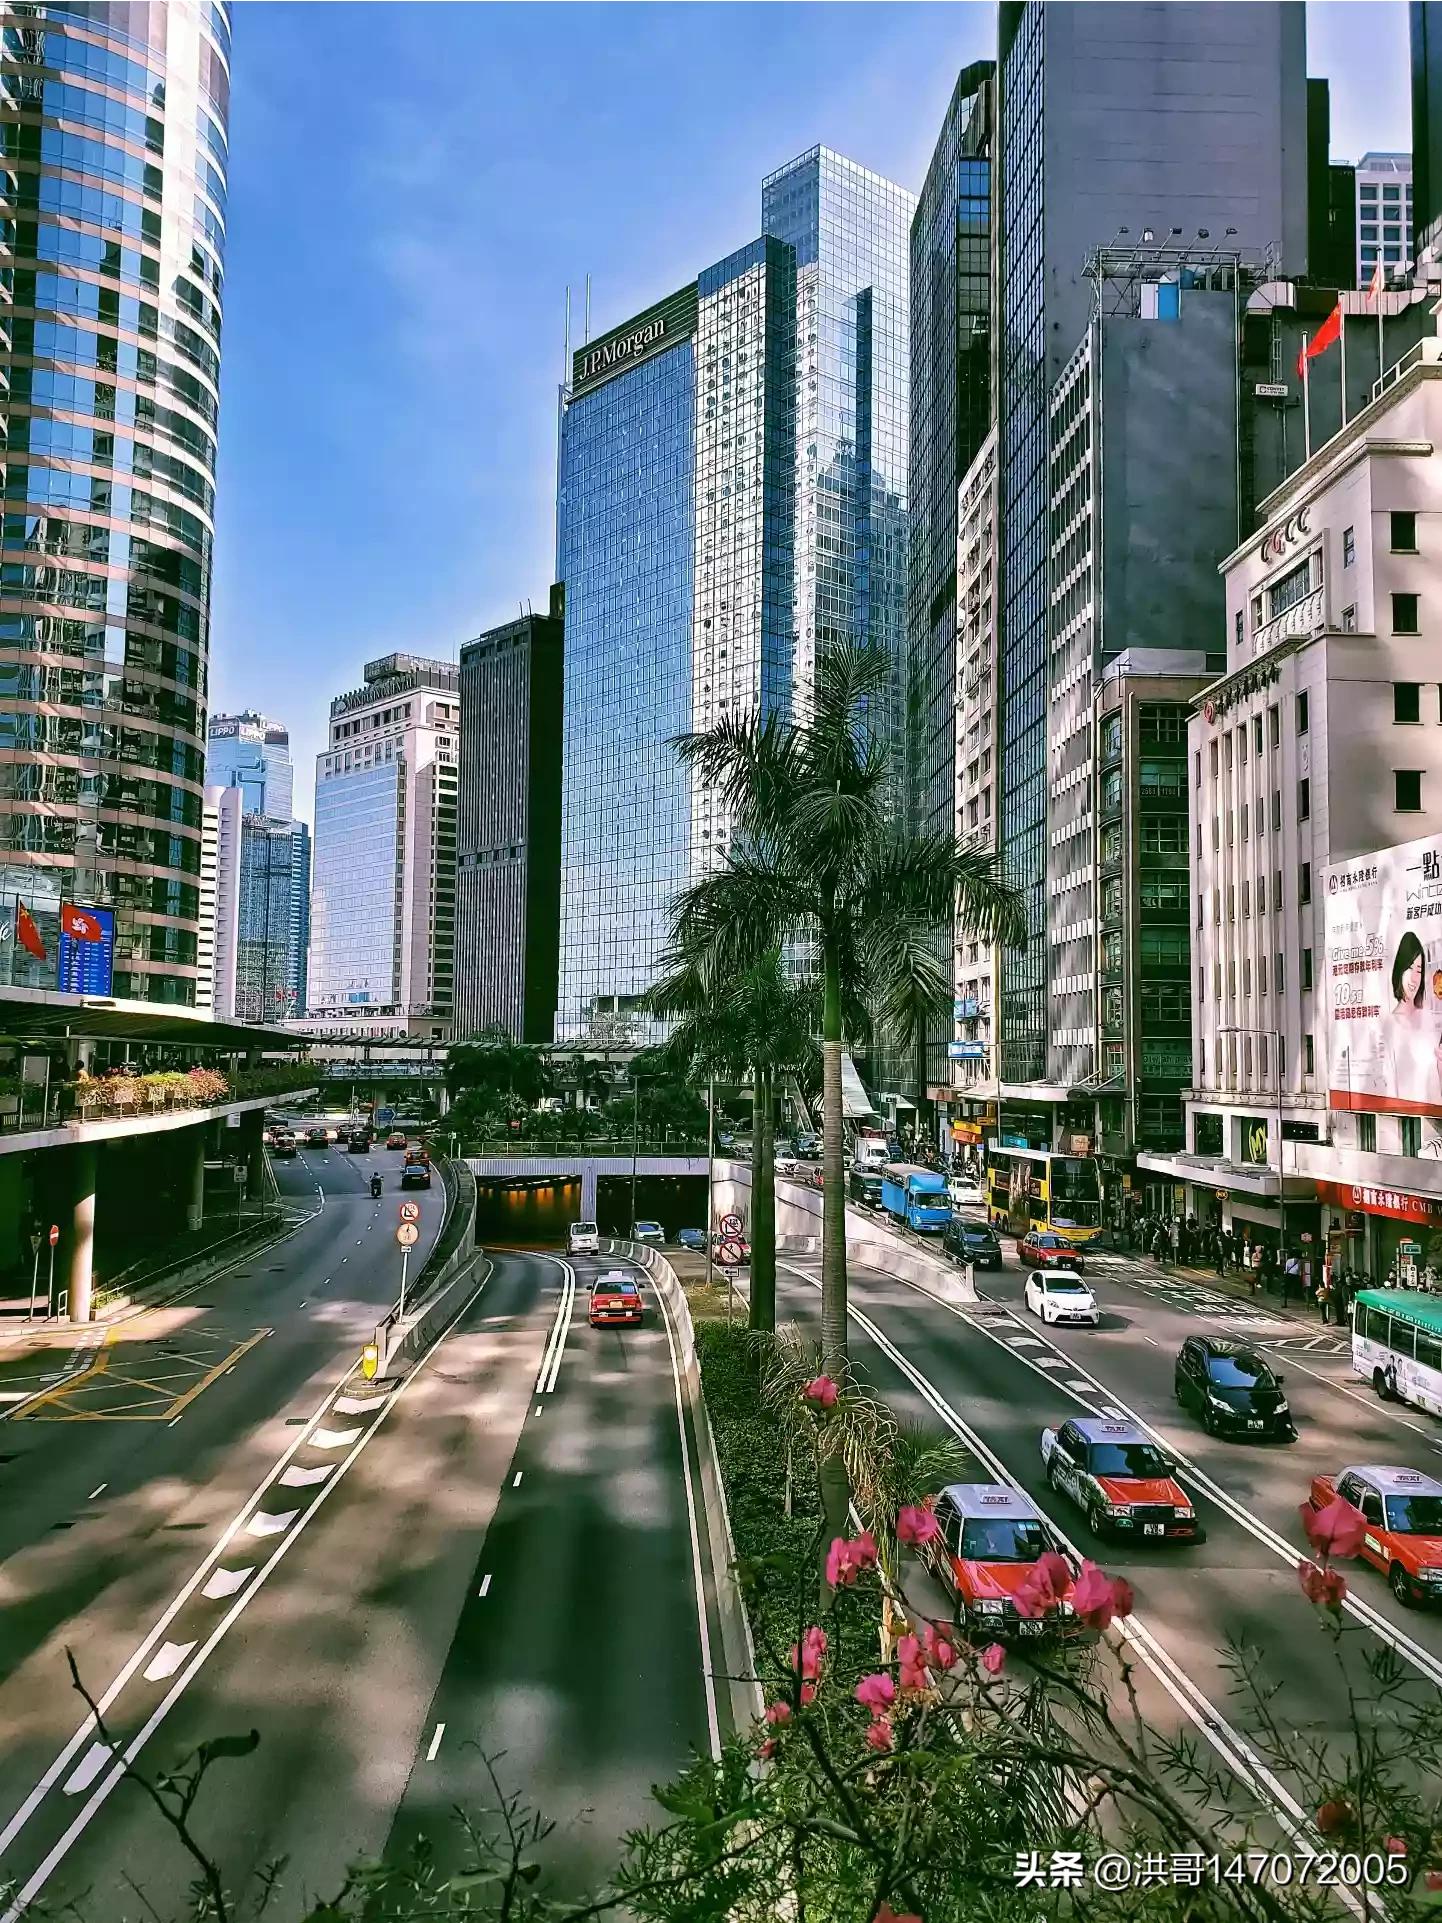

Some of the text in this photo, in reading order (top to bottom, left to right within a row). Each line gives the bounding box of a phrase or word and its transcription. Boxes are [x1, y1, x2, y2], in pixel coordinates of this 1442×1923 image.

[579, 319, 665, 380] J.P.Morgan
[209, 726, 235, 736] LIPPO
[1406, 849, 1442, 881] 一點
[1412, 1200, 1433, 1214] CMB
